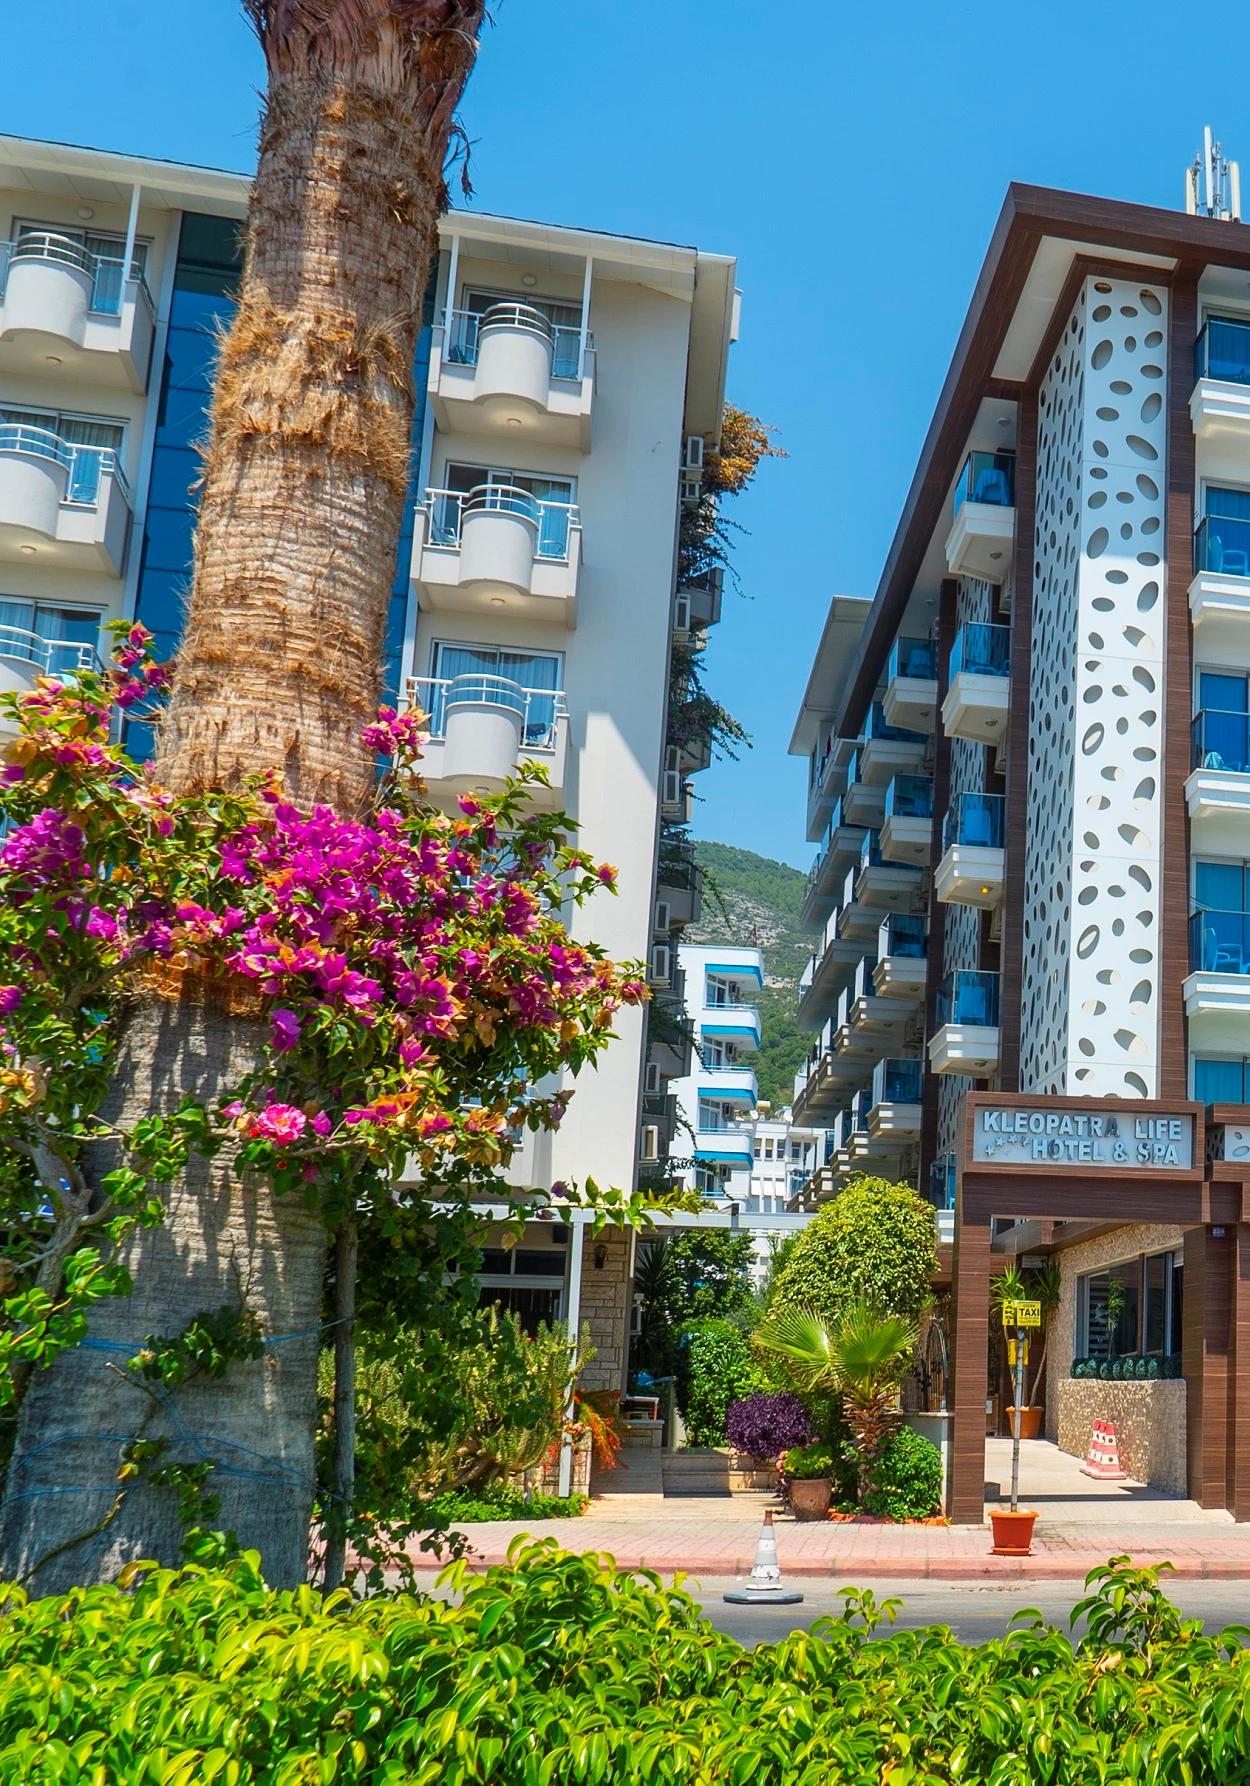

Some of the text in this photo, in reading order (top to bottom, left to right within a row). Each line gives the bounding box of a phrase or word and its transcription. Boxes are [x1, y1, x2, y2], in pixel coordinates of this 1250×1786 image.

[983, 1110, 1182, 1141] KLEOPATRA LIFE
[1031, 1138, 1179, 1165] HOTEL & SPA
[1019, 1308, 1039, 1316] TAXI
